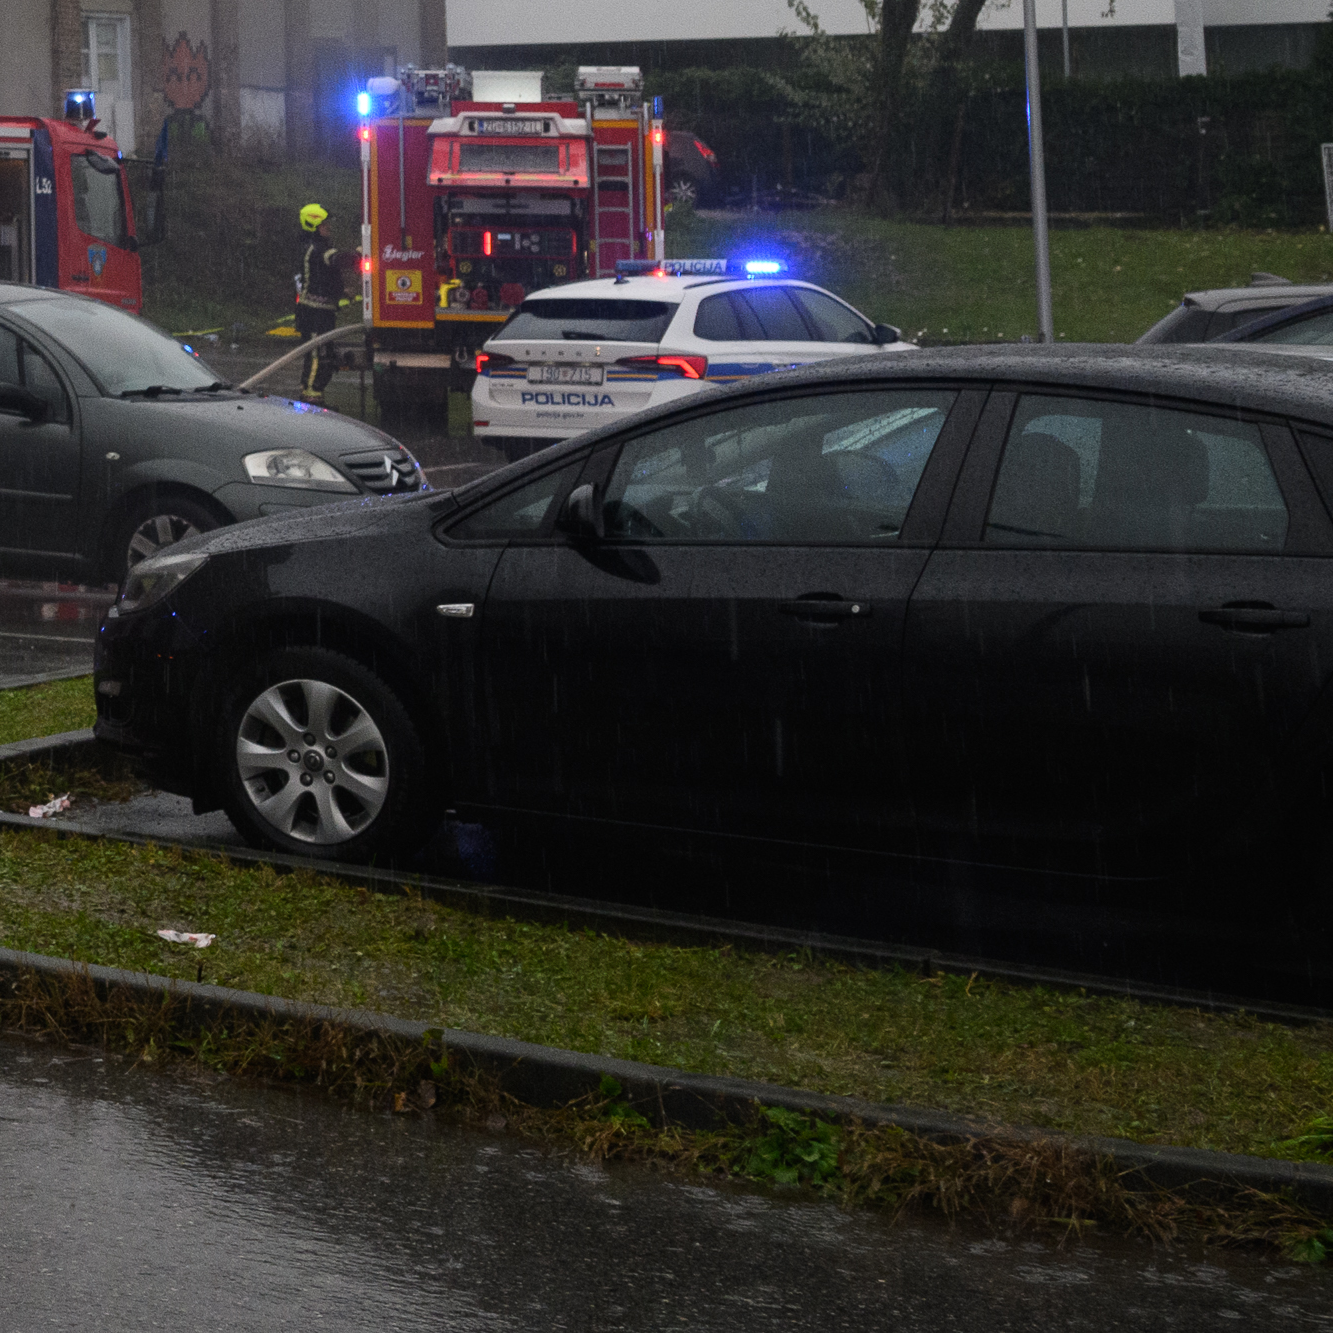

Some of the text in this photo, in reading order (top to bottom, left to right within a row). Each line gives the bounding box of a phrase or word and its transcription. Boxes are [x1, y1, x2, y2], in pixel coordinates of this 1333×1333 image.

[664, 261, 723, 273] POLICIJA
[540, 367, 560, 380] 190
[521, 392, 615, 407] POLICIJA
